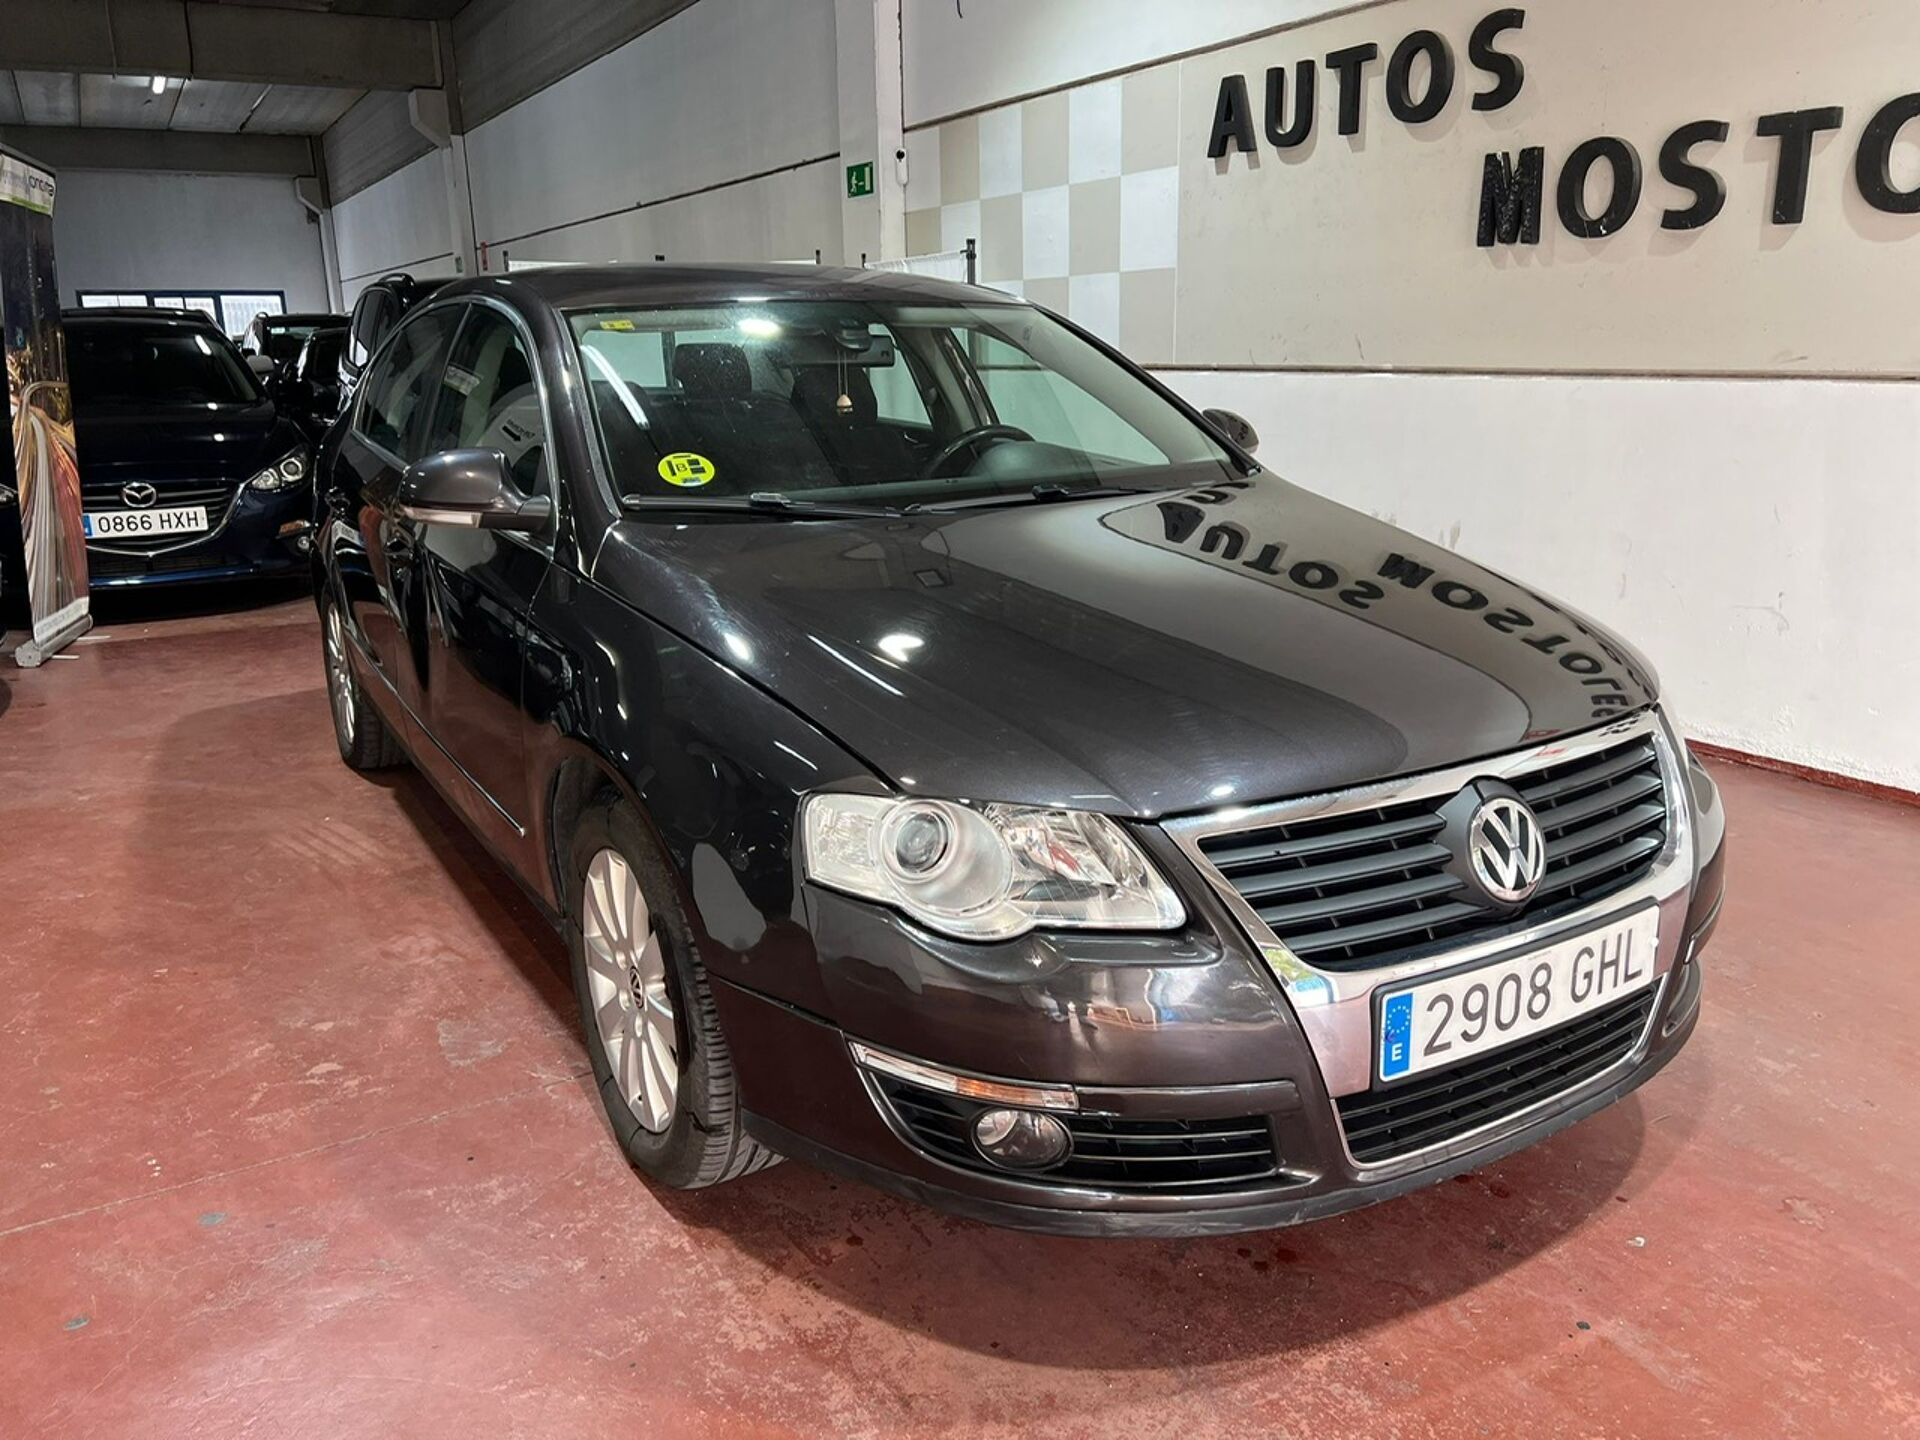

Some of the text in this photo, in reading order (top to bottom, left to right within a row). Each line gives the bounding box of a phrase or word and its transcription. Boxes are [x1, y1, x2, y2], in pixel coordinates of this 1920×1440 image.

[1207, 9, 1524, 158] AUTOS
[1476, 92, 1920, 247] MOSTO
[98, 514, 152, 533] 0866
[159, 511, 199, 529] HXH
[1391, 1043, 1402, 1061] E
[1423, 928, 1643, 1057] 2908 GHL
